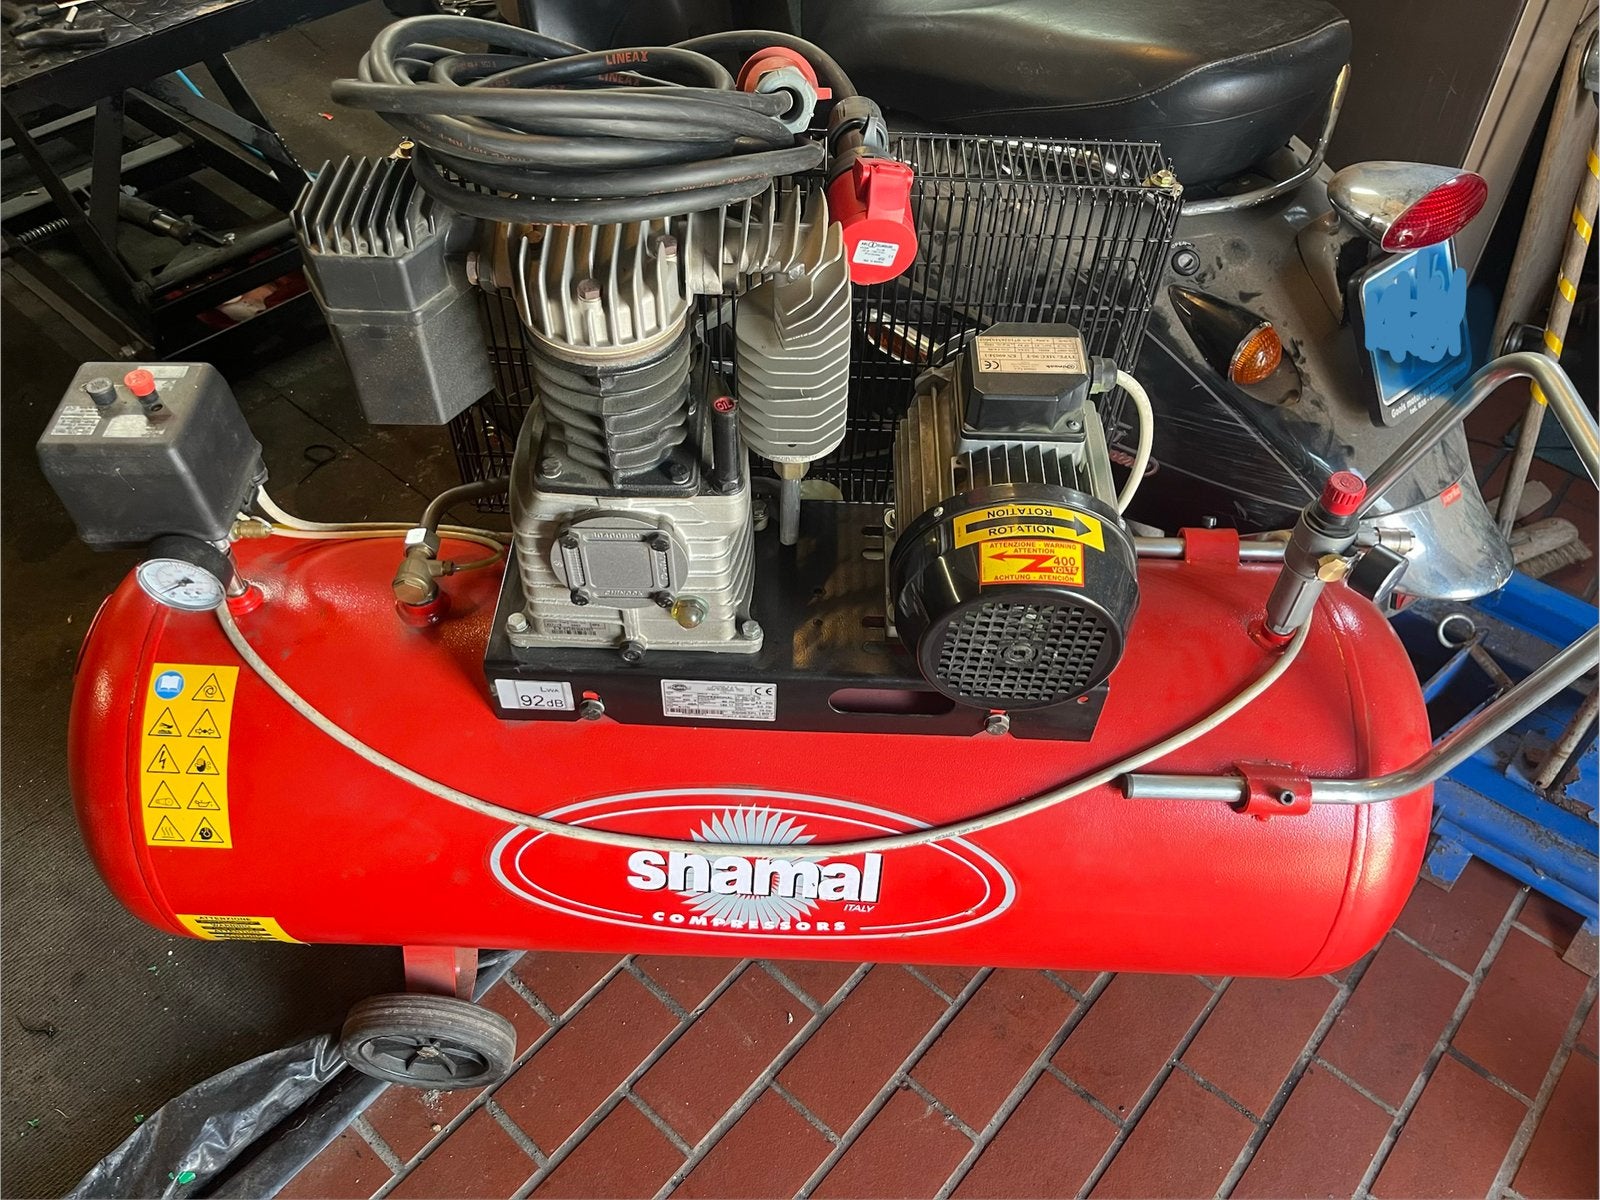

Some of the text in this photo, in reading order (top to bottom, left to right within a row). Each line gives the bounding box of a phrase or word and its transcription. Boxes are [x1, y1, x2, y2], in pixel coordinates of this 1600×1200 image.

[605, 51, 648, 66] LINEAX
[987, 507, 1053, 519] ROTATION
[988, 525, 1055, 537] ROTATION
[989, 541, 1036, 549] ATTENZIONE
[1043, 541, 1077, 550] WARNING
[1053, 557, 1076, 566] 400
[1051, 566, 1078, 574] VOLTS
[843, 904, 875, 913] ITALY
[652, 912, 846, 932] COMPRESSORS
